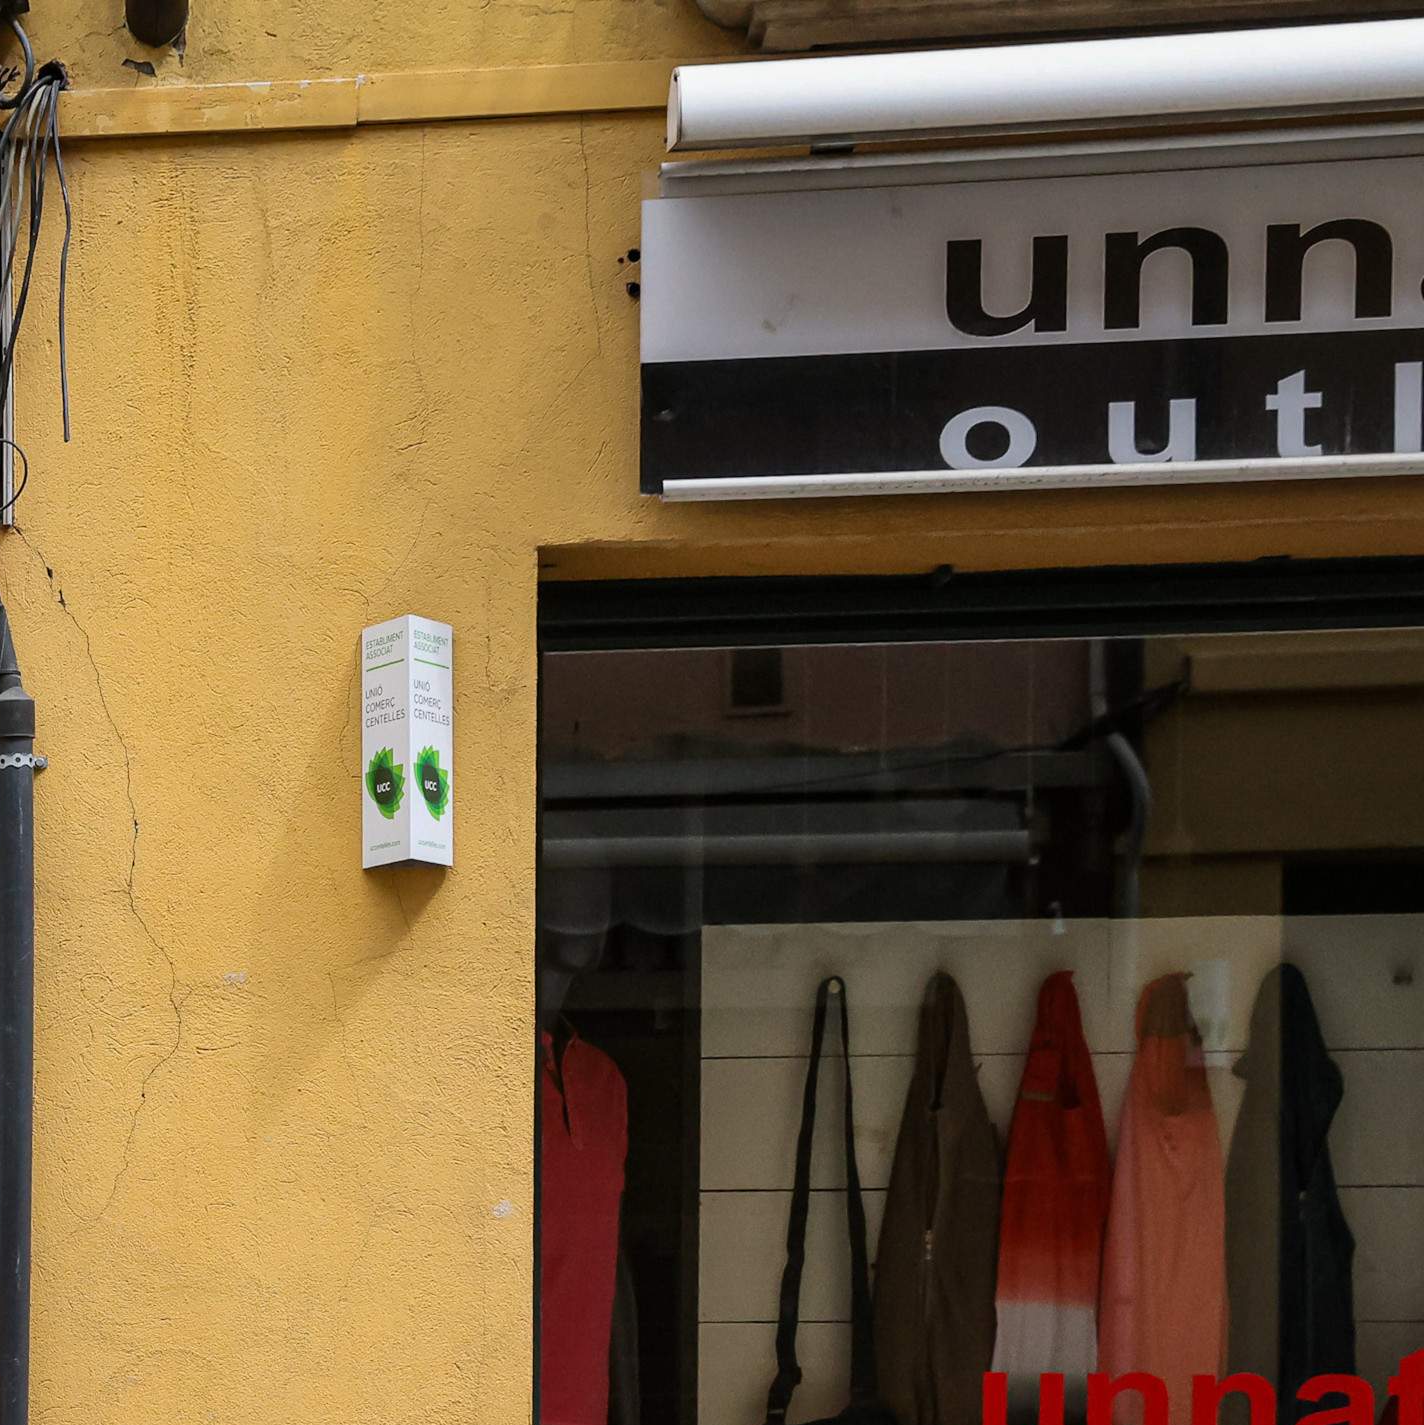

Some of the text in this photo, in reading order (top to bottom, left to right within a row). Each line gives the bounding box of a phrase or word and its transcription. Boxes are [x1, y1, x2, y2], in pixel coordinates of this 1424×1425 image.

[945, 217, 1424, 337] unn
[939, 361, 1424, 468] outl
[365, 709, 405, 729] CENTELLES
[413, 708, 450, 726] CENTELLES
[376, 781, 391, 793] UCC
[425, 780, 437, 792] UCC
